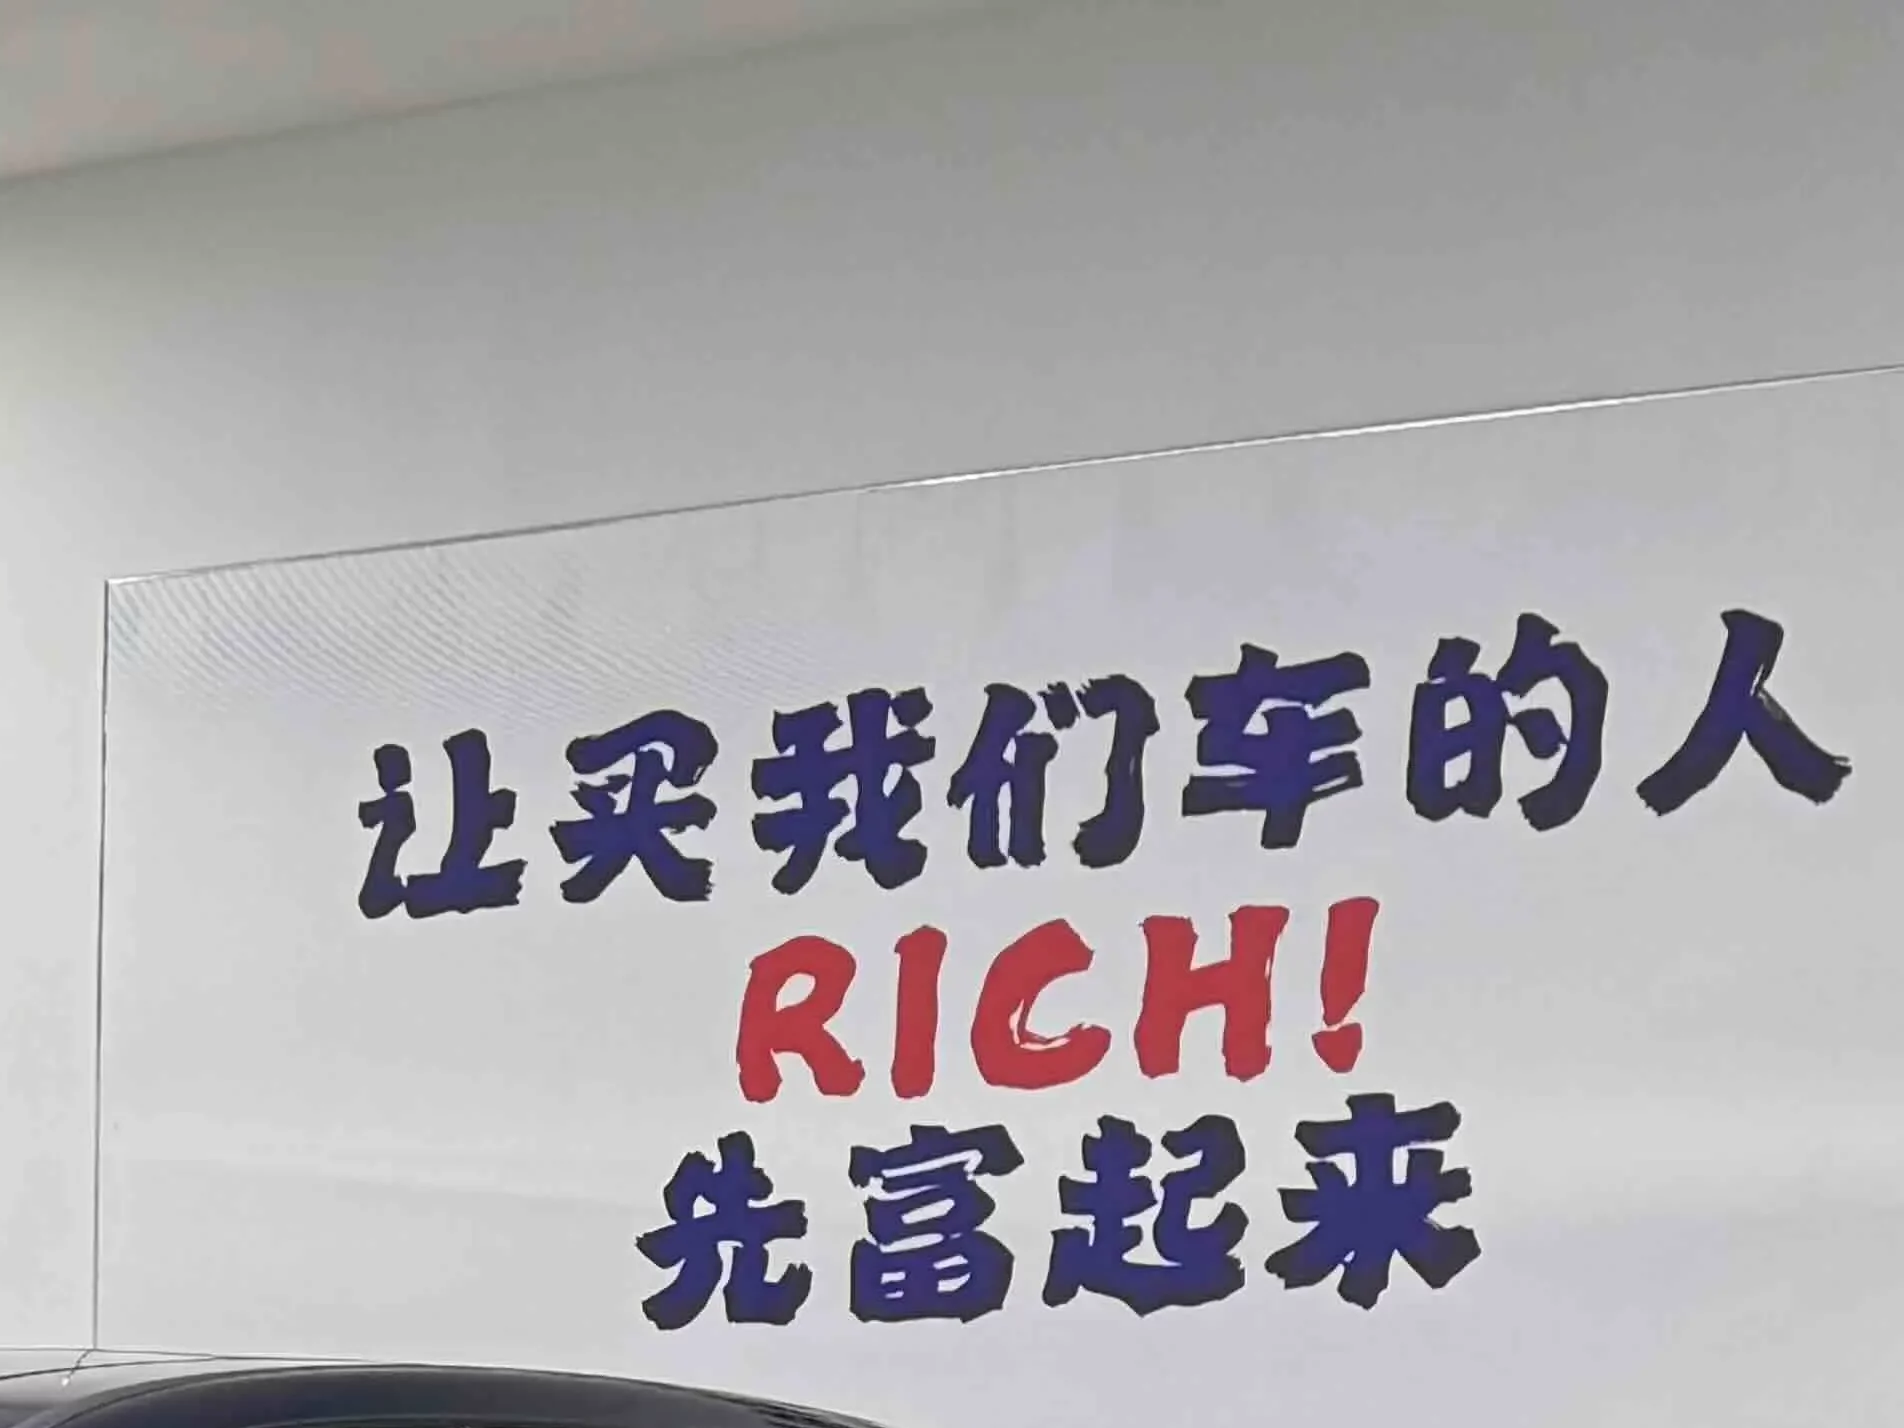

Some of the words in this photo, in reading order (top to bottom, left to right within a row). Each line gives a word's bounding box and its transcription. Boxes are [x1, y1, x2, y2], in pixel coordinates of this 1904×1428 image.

[356, 608, 1853, 920] 让买我们车的人
[735, 897, 1382, 1104] RICH!
[635, 1093, 1482, 1332] 先富起来
